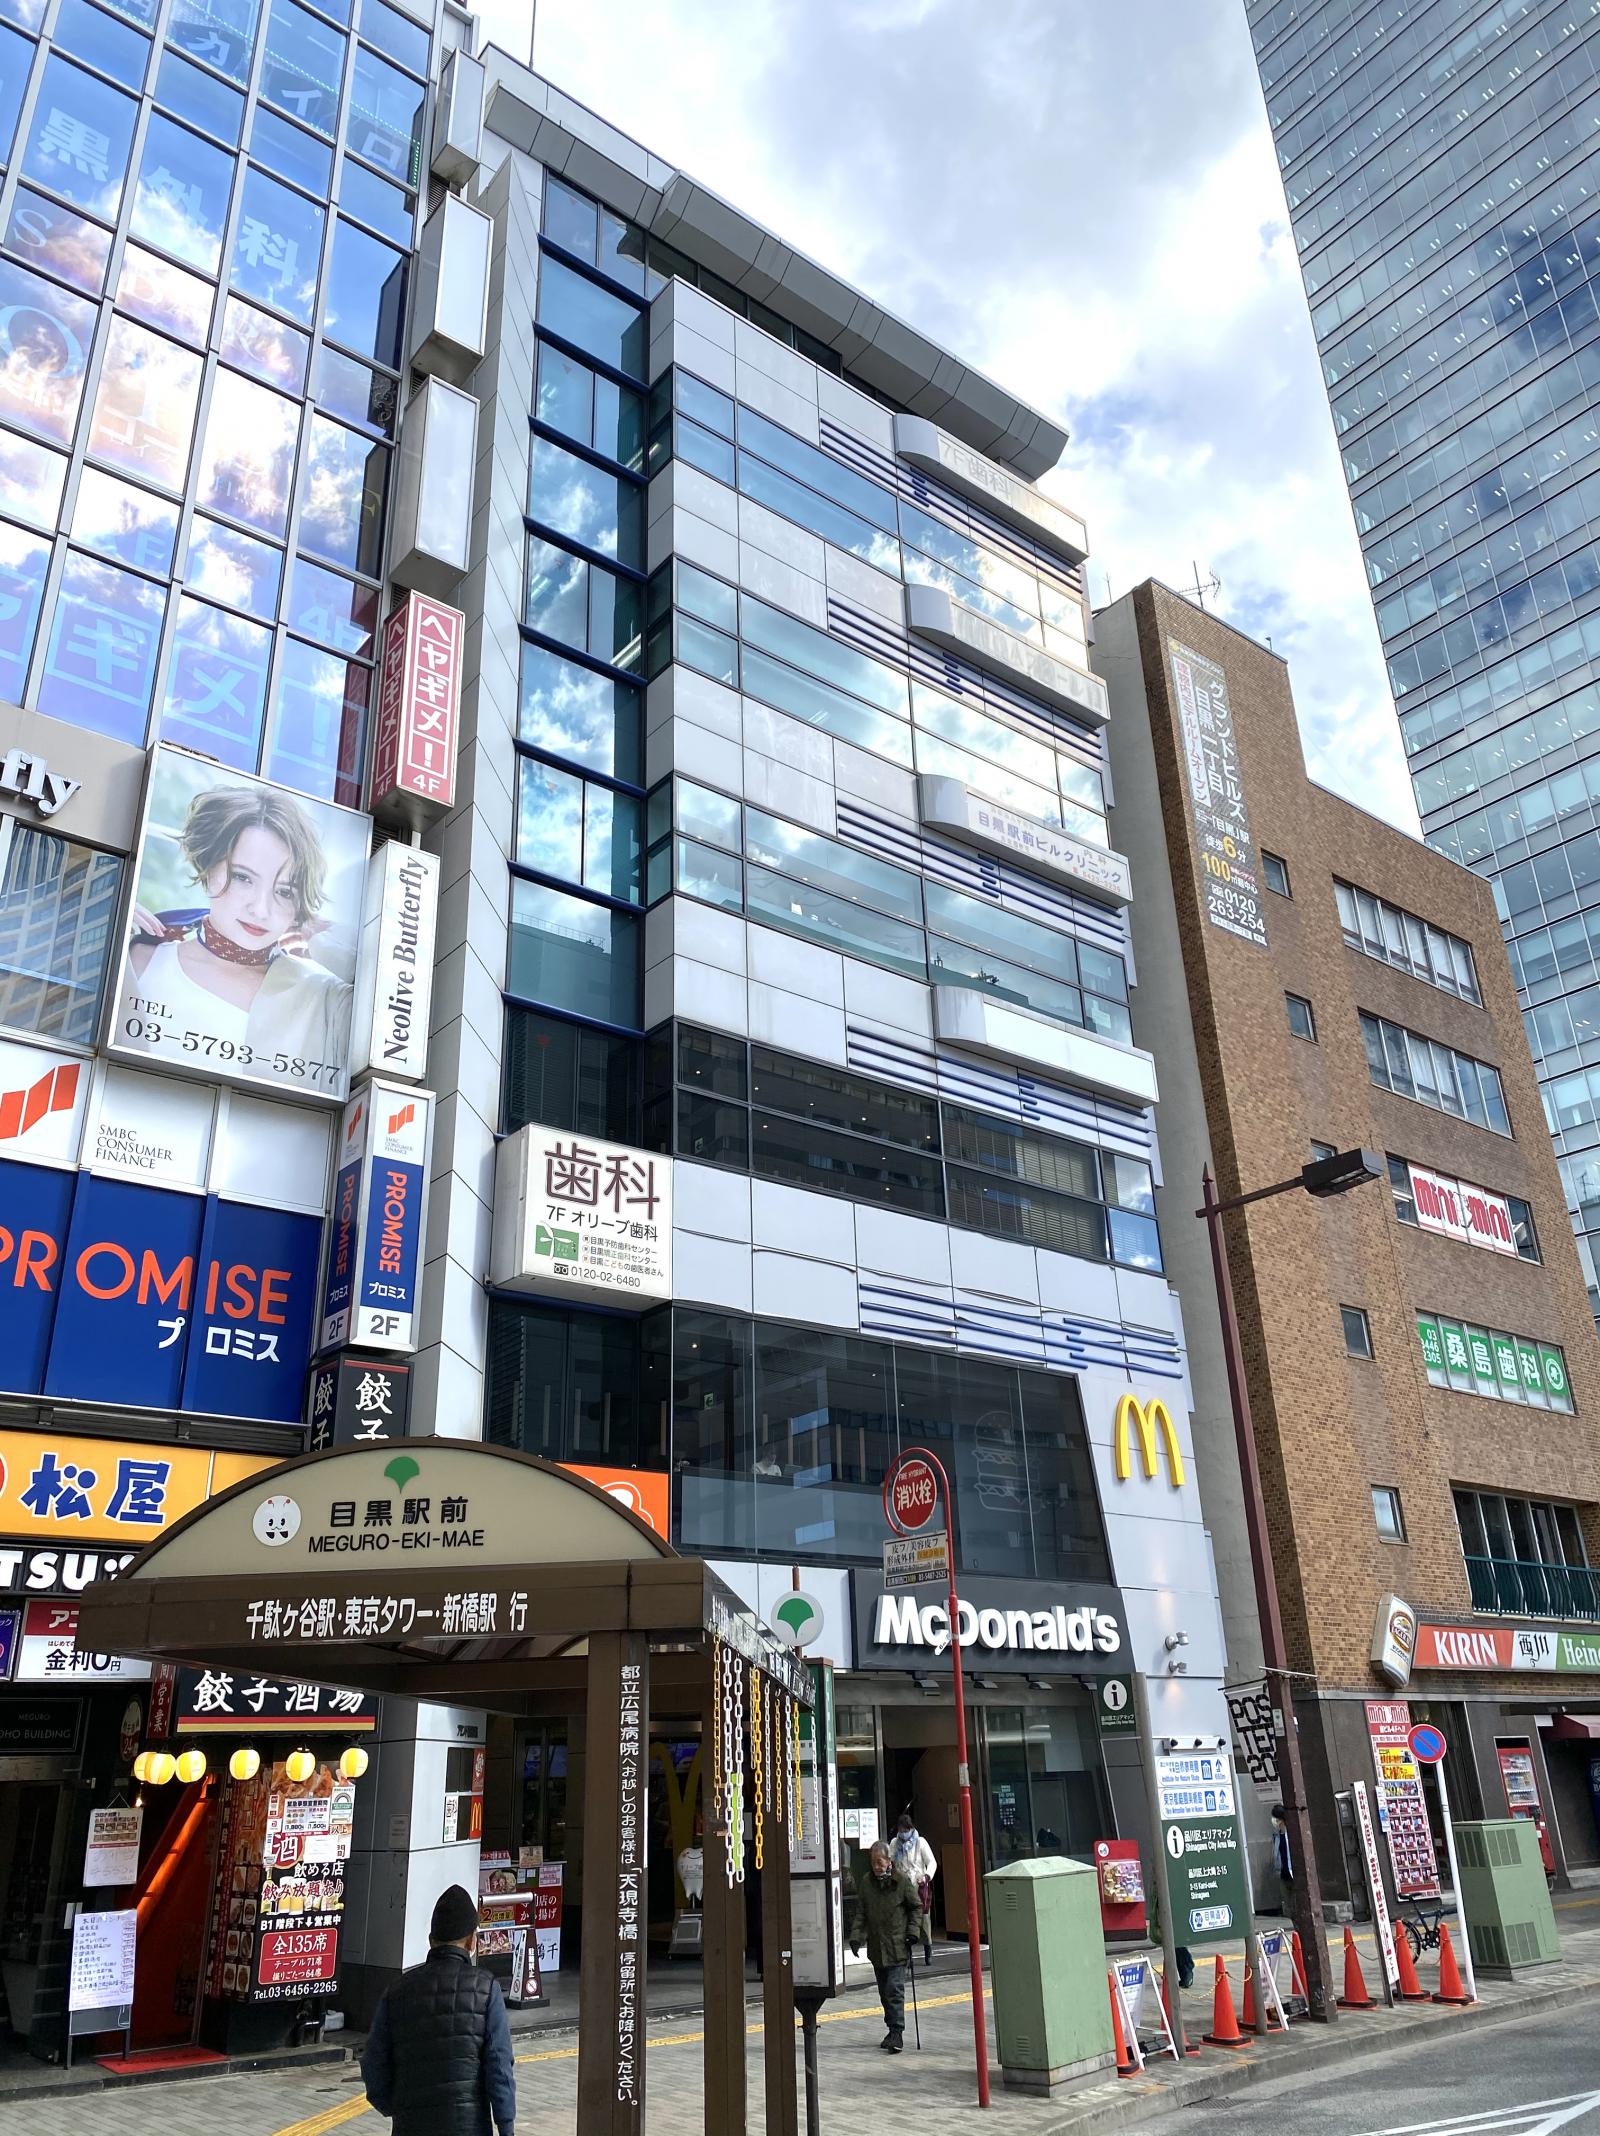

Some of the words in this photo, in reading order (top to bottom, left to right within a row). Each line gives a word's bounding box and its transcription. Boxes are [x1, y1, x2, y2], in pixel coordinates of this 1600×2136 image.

[1195, 686, 1225, 796] 目黒一丁目
[1209, 680, 1246, 823] グランドヒルズ
[376, 774, 393, 797] 4F
[413, 773, 441, 794] 4F
[394, 856, 429, 963] Butterfly
[1208, 895, 1266, 933] 263-254
[1224, 888, 1256, 914] 0120
[128, 997, 173, 1020] TEL
[384, 969, 416, 1064] Neolive
[125, 1017, 341, 1085] 03-5793-5877
[99, 1124, 137, 1142] SMBC
[96, 1148, 156, 1170] FINANCE
[97, 1137, 173, 1161] CONSUMER
[545, 1142, 661, 1220] 歯科
[336, 1174, 355, 1277] PROMISE
[379, 1171, 408, 1274] PROMISE
[546, 1204, 567, 1221] 7F
[571, 1210, 659, 1243] オリーブ歯科
[368, 1281, 406, 1300] プロミス
[571, 1266, 641, 1288] 0120-02-6480
[158, 1316, 280, 1363] プロミス
[328, 1316, 345, 1340] 2F
[370, 1315, 400, 1336] 2F
[1426, 1329, 1437, 1341] 03
[1446, 1332, 1542, 1388] 桑島歯科
[18, 1451, 172, 1526] 松屋
[897, 1479, 932, 1511] 消火栓
[329, 1495, 469, 1528] 目黒駅前
[308, 1530, 485, 1553] MEGURO-EKI-MAE
[510, 1591, 529, 1632] 行
[874, 1595, 1121, 1653] McDonald's
[1433, 1630, 1500, 1666] KIRIN
[24, 1729, 71, 1739] BUILDING
[262, 1879, 344, 1900] 飲み放題あり
[260, 1920, 272, 1931] B1
[273, 1933, 327, 1955] 全135席
[274, 1959, 305, 1969] テーブル
